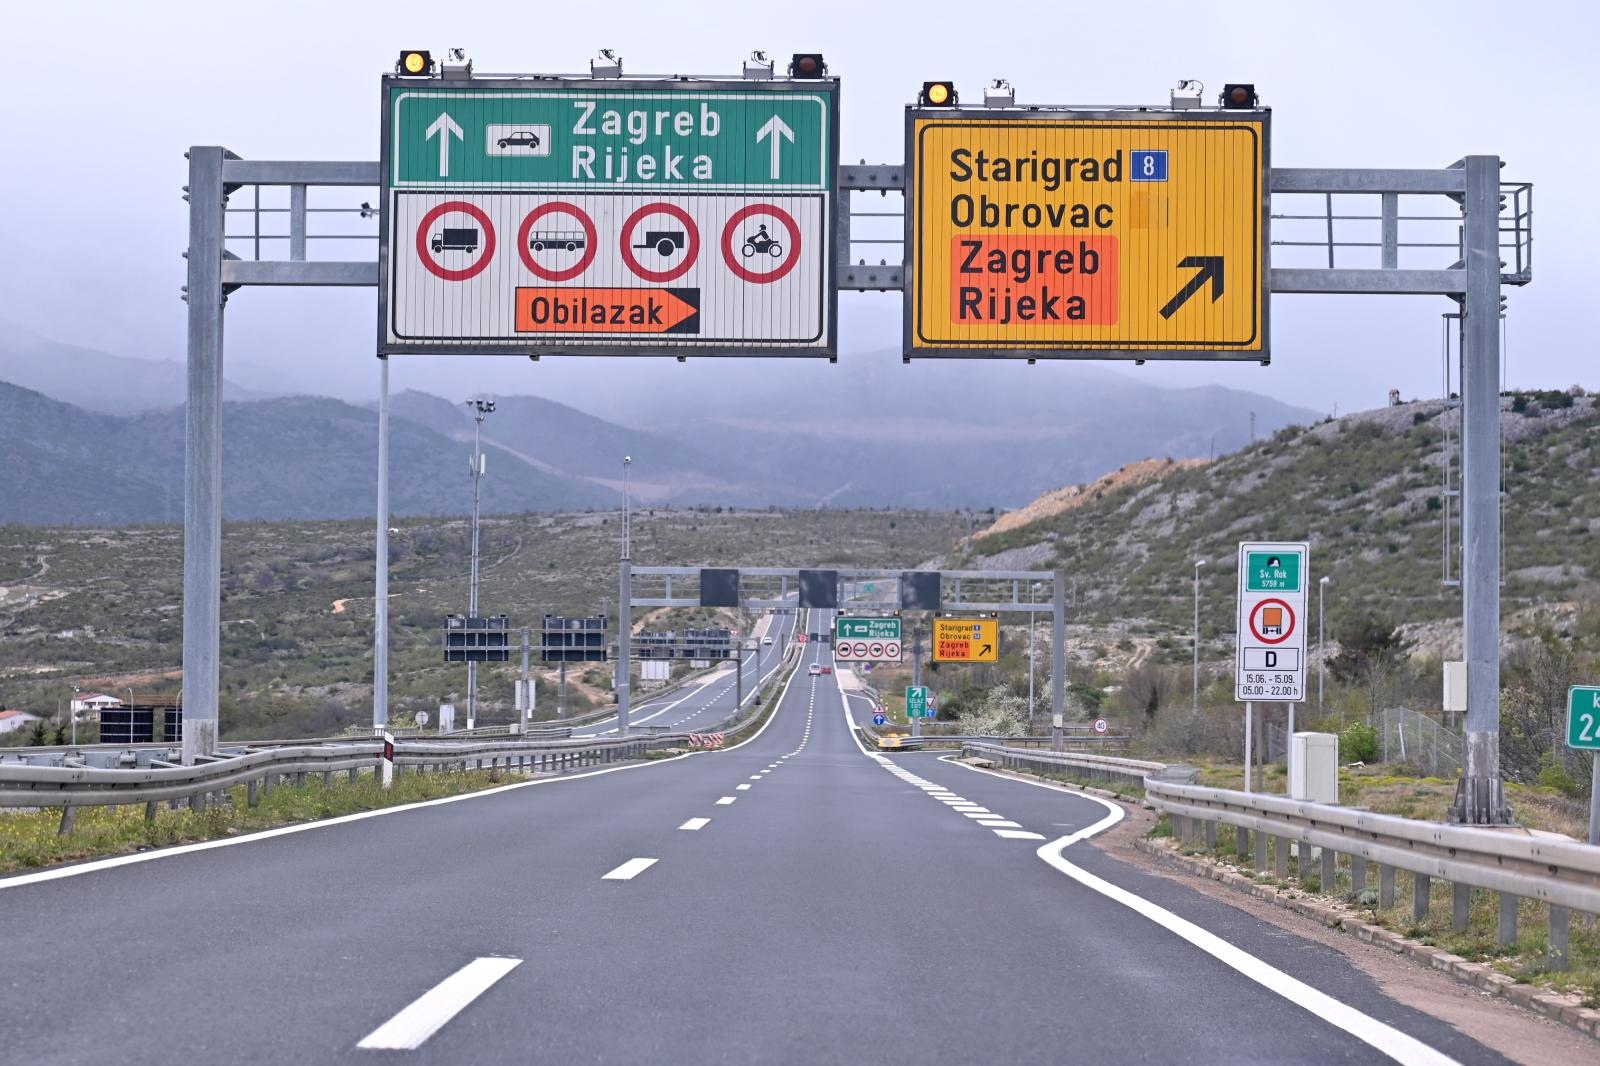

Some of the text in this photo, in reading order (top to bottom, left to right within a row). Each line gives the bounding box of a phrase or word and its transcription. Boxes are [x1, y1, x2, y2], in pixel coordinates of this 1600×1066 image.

[572, 101, 721, 144] Zagreb
[571, 145, 714, 184] Rijeka
[950, 148, 1155, 192] Starigrad 8
[950, 194, 1114, 228] Obrovac
[959, 240, 1099, 283] Zagreb
[531, 297, 663, 326] Obilazak
[959, 287, 1086, 324] Rijeka
[1260, 569, 1287, 579] Sv. Rok
[869, 621, 896, 630] Zagreb
[940, 624, 973, 632] Starigrad
[868, 629, 895, 638] Rijeka
[940, 641, 969, 649] Zagreb
[940, 650, 966, 659] Rijeka
[1265, 651, 1277, 667] D
[1246, 674, 1267, 684] 15.06.
[1274, 674, 1295, 684] 15.09.
[1243, 685, 1264, 695] 05.00
[1271, 686, 1292, 695] 22.00
[1293, 686, 1298, 695] h
